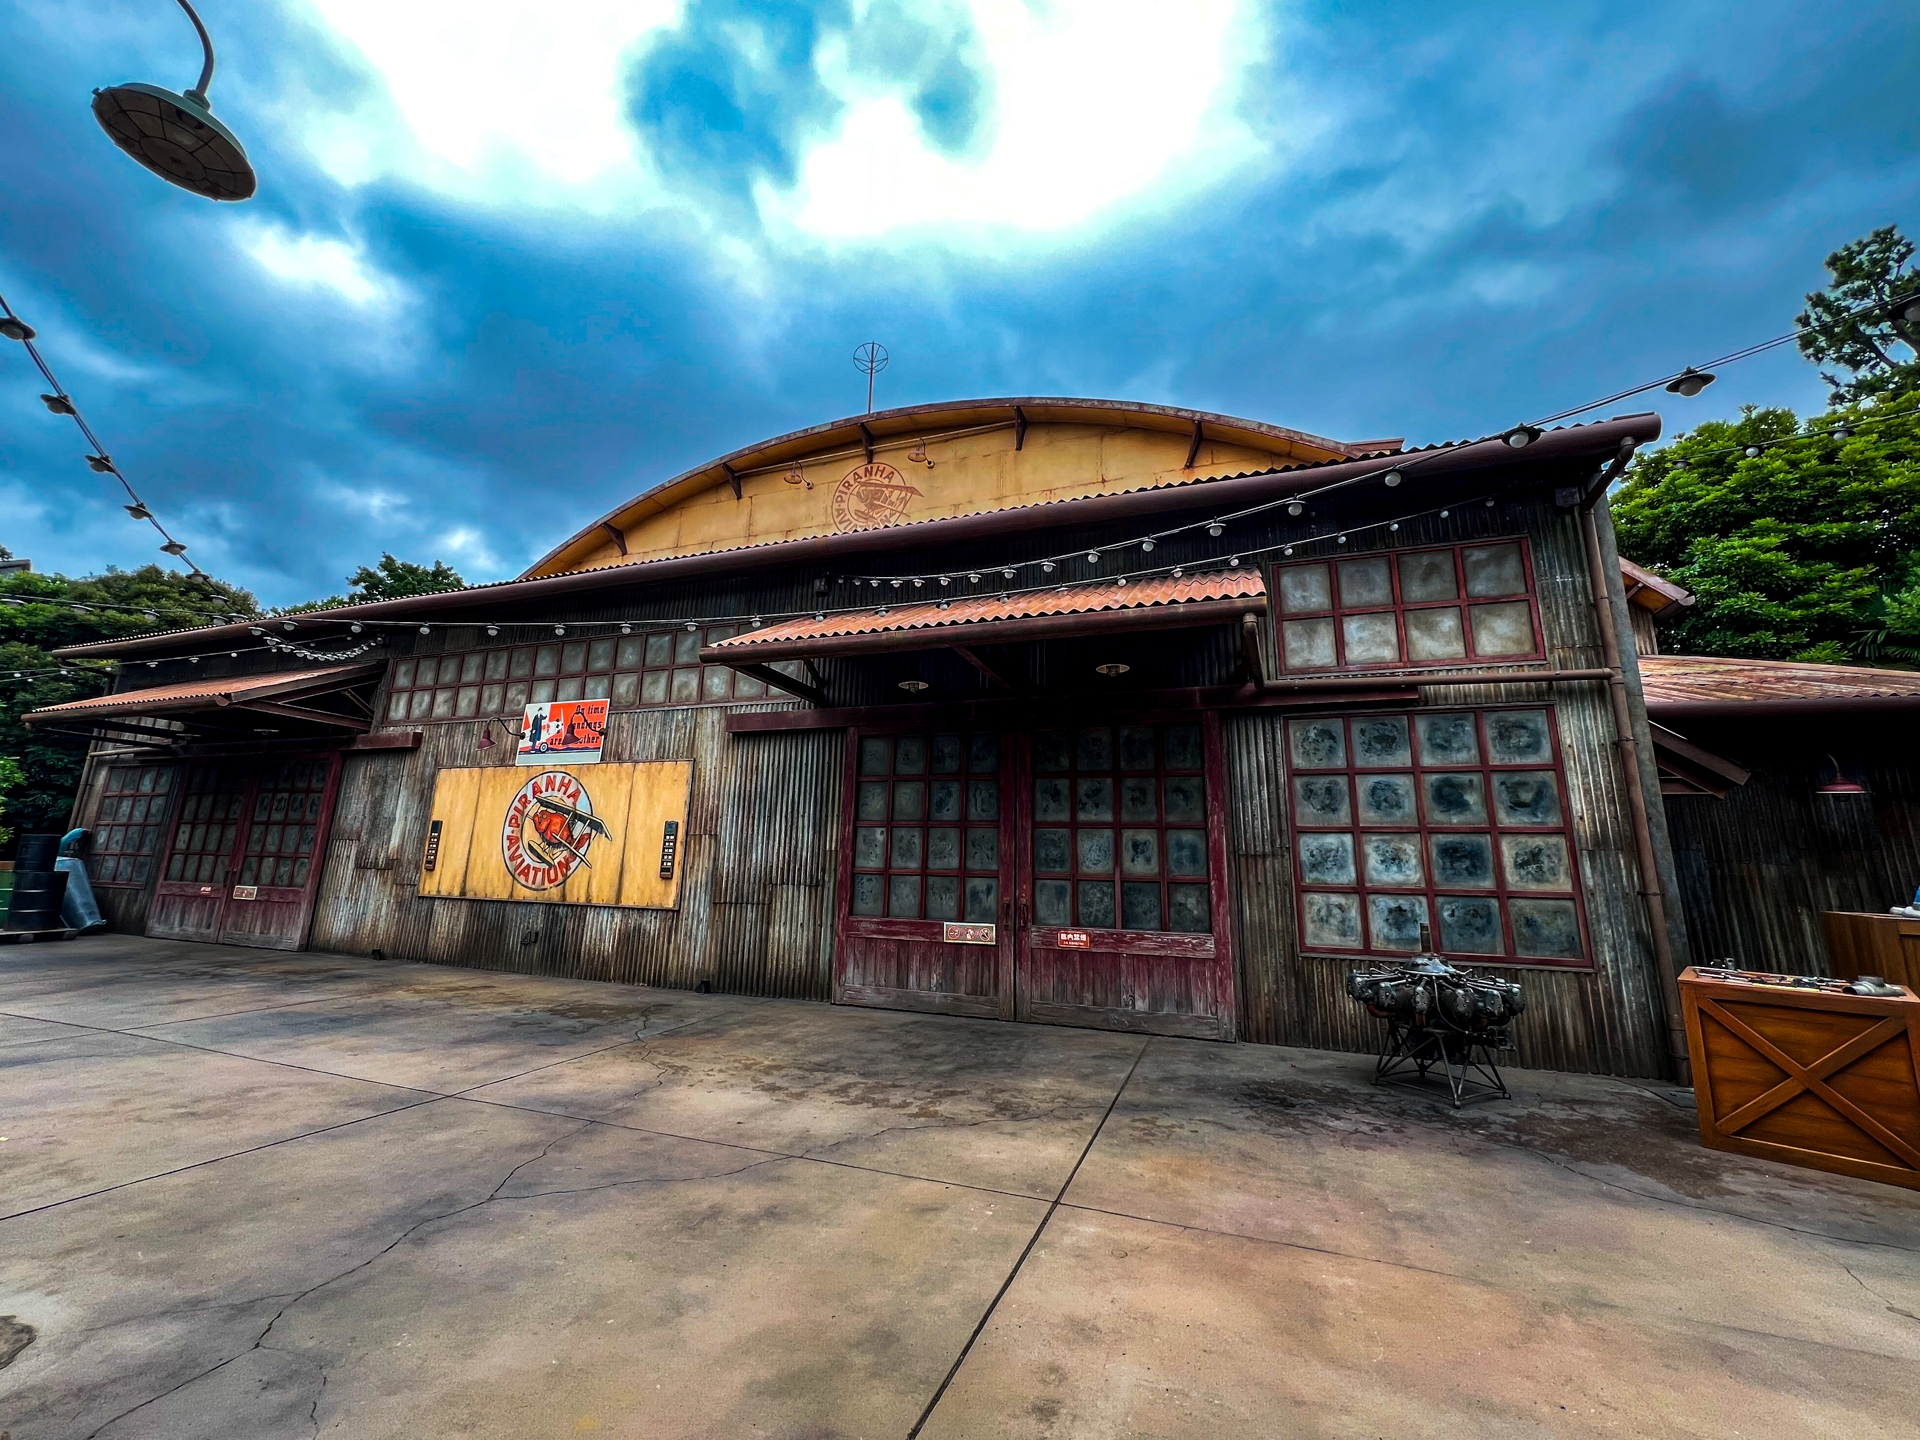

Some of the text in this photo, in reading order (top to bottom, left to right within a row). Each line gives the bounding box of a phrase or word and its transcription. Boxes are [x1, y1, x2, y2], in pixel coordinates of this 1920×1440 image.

[834, 465, 896, 504] PIRANHA
[834, 507, 893, 533] AVIAN
[588, 705, 604, 714] time
[507, 774, 582, 829] PIRANHA
[506, 834, 572, 886] AVIATION
